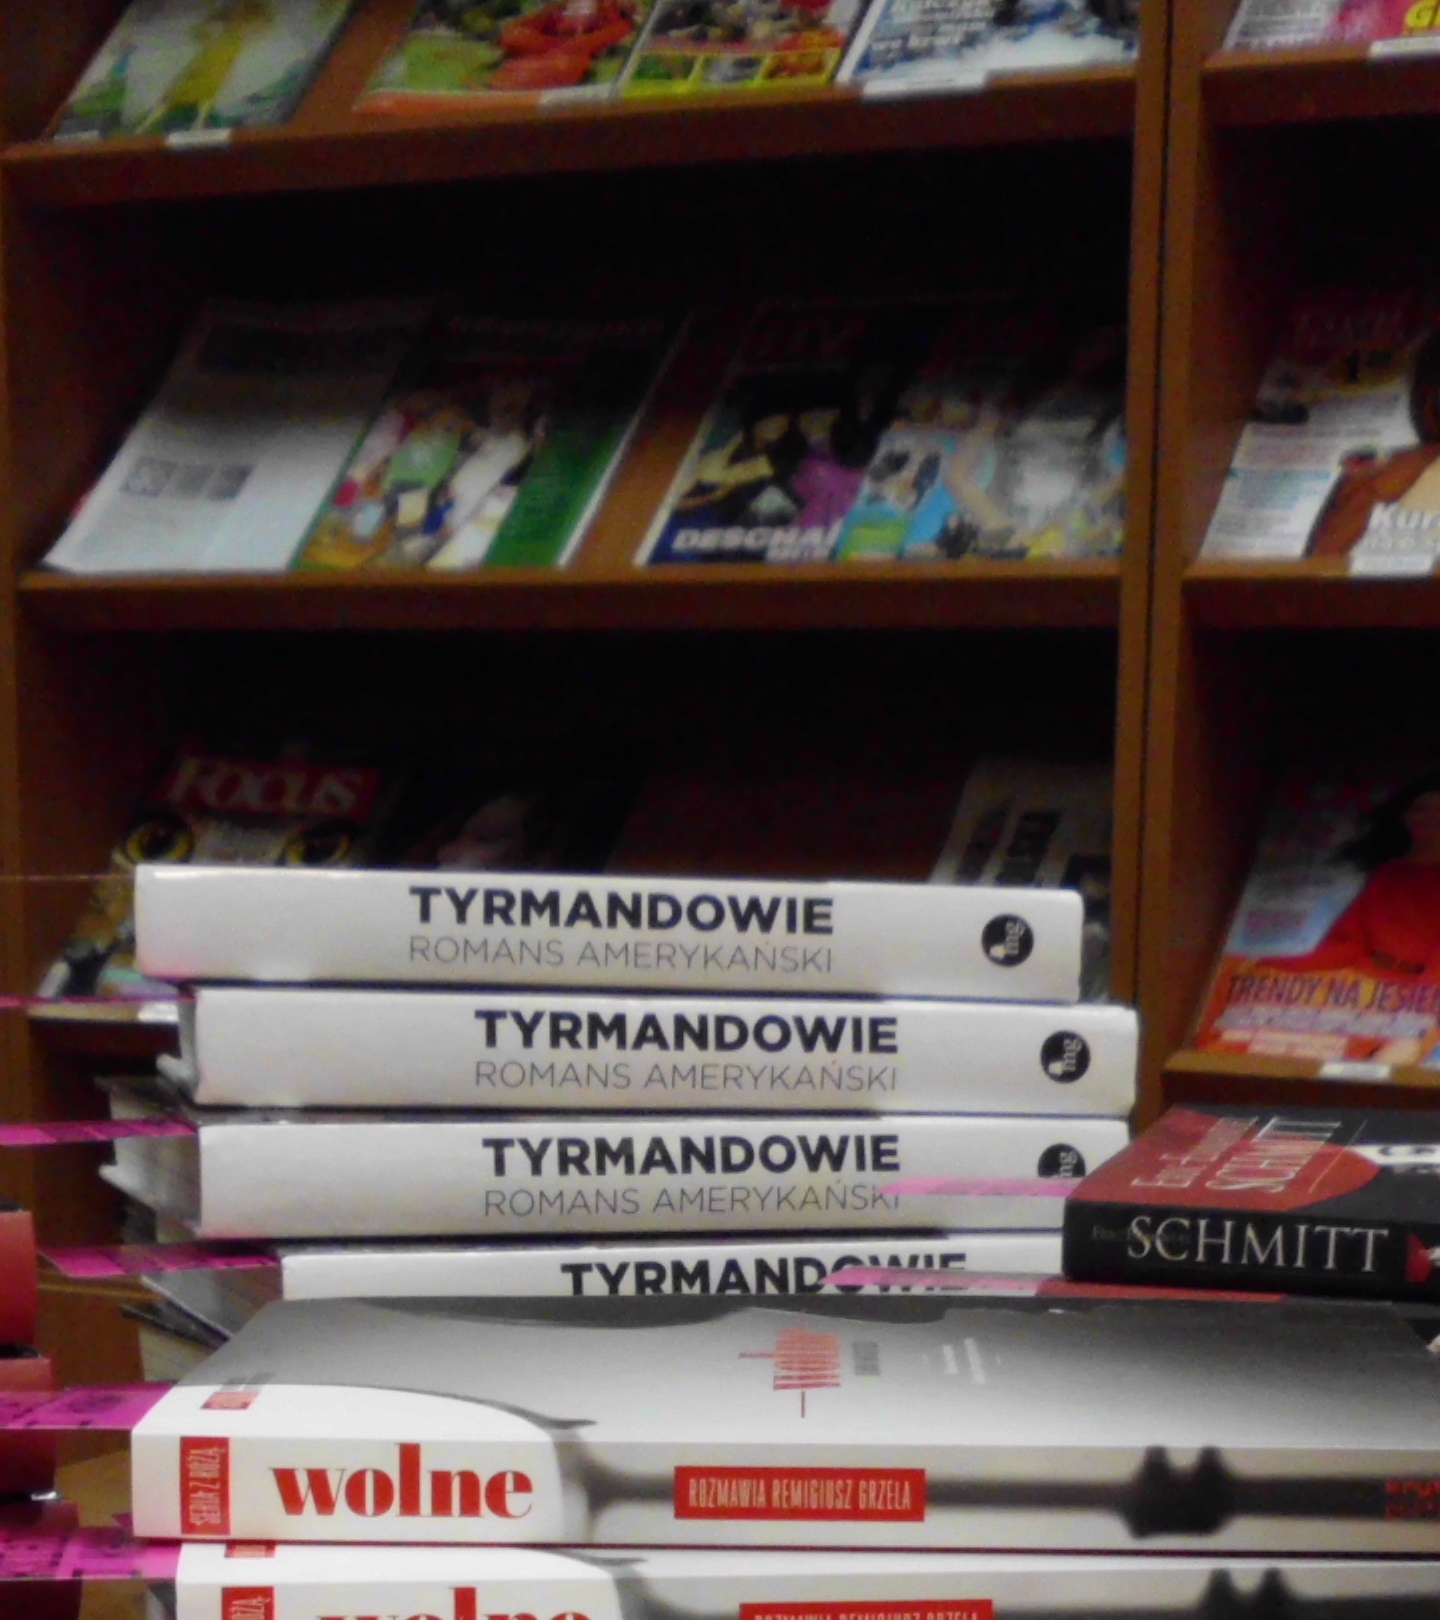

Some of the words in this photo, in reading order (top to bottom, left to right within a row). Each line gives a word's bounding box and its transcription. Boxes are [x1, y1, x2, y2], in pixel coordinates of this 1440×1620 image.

[409, 885, 834, 936] TYRMANDOWIE
[409, 936, 564, 968] ROMANS
[576, 936, 834, 974] AMERYKAŃSKI
[474, 1008, 899, 1055] TYRMANDOWIE
[475, 1060, 631, 1091] ROMANS
[644, 1058, 898, 1093] AMERYKAŃSKI
[482, 1134, 901, 1178] TYRMANDOWIE
[483, 1184, 641, 1218] ROMANS
[651, 1179, 901, 1215] AMERYKAŃSKI
[1126, 1215, 1389, 1273] SCHMITT
[270, 1443, 534, 1519] wolne
[688, 1477, 767, 1509] ROZMAWIA
[772, 1478, 854, 1509] REMIGIUSZ
[859, 1479, 912, 1510] GRZELA
